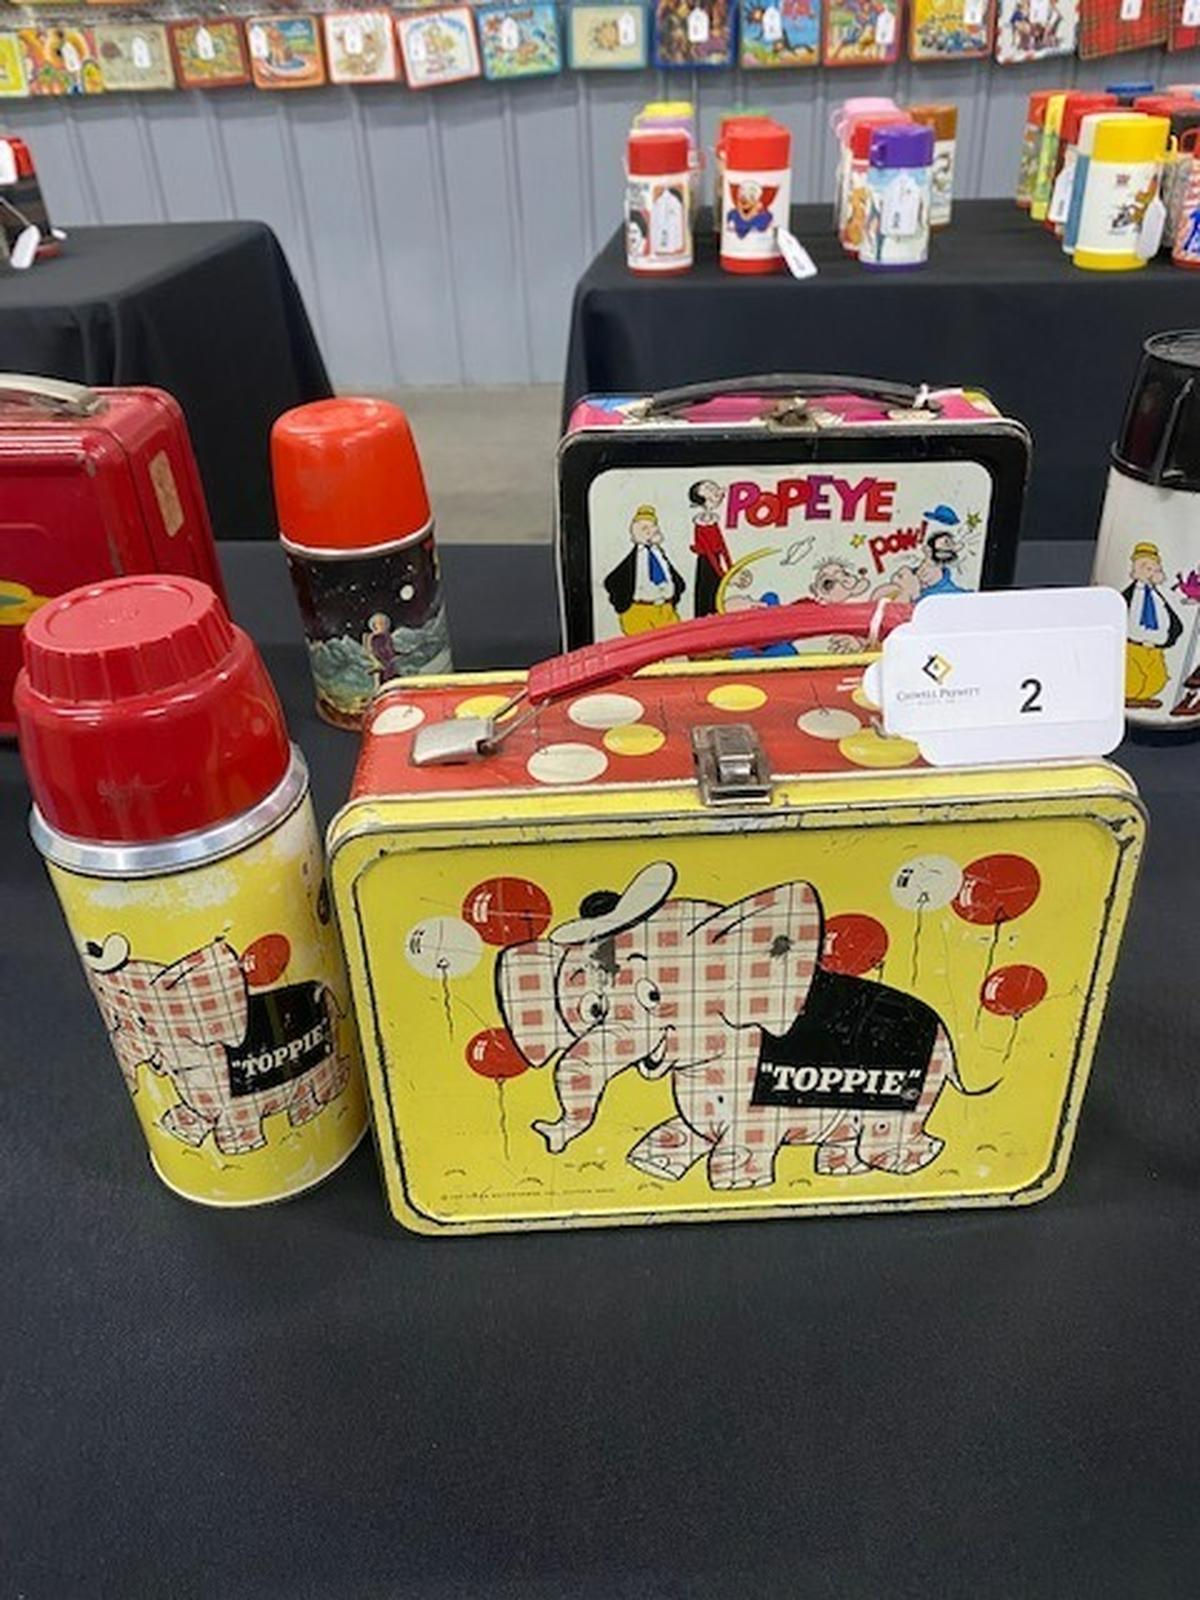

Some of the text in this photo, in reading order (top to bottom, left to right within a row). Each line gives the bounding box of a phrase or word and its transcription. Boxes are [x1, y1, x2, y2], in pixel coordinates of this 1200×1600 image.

[725, 474, 896, 529] POPEYE
[1020, 678, 1042, 713] 2
[760, 1061, 922, 1096] "TOPPIE"
